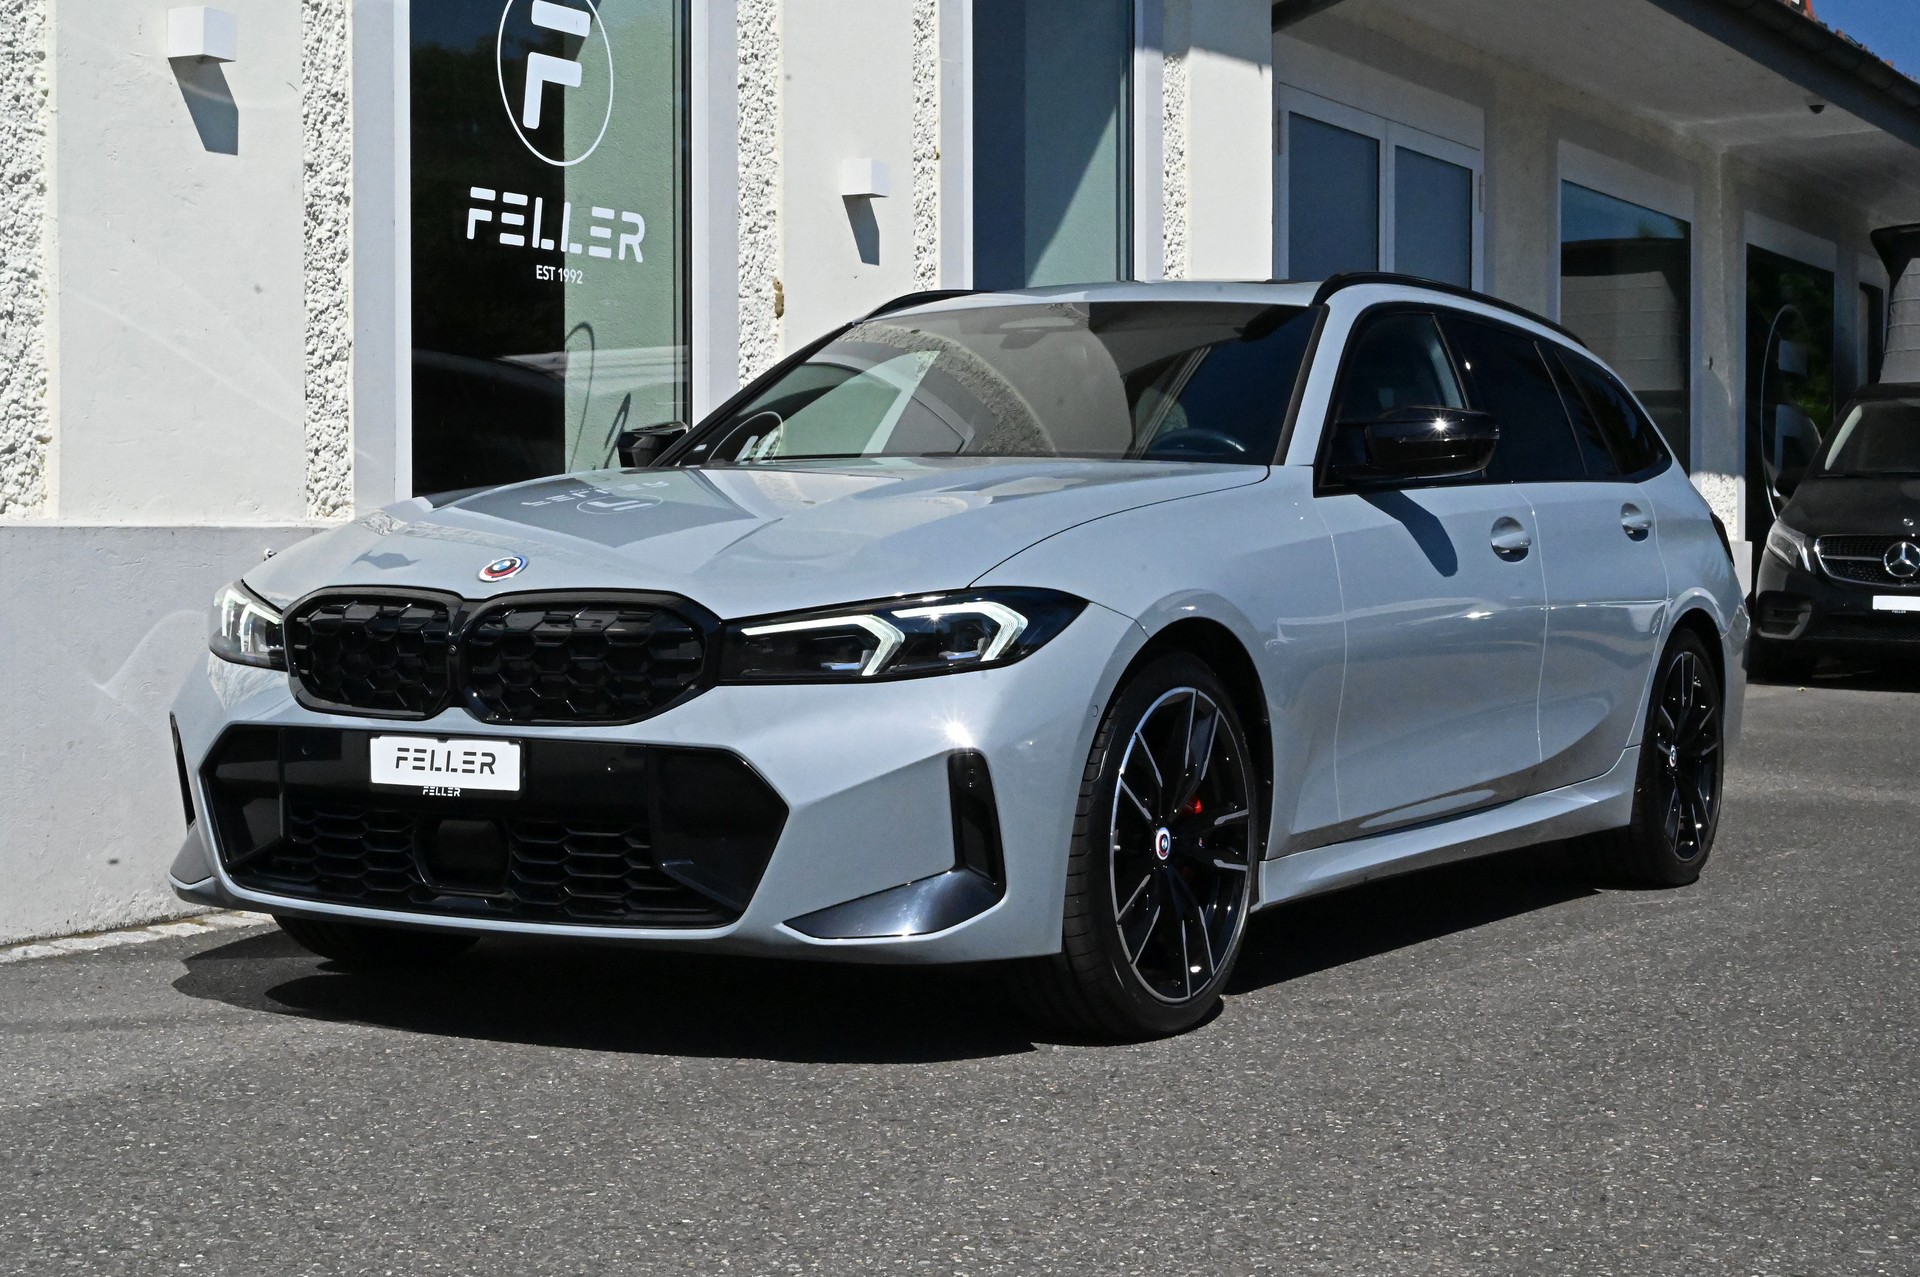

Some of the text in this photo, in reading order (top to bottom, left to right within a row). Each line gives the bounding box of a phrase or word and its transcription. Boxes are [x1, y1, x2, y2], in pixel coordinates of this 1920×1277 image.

[523, 0, 591, 129] F
[467, 187, 645, 262] FELLER
[536, 265, 583, 284] EST 1992
[395, 747, 496, 775] FELLER
[423, 786, 460, 797] FELLER
